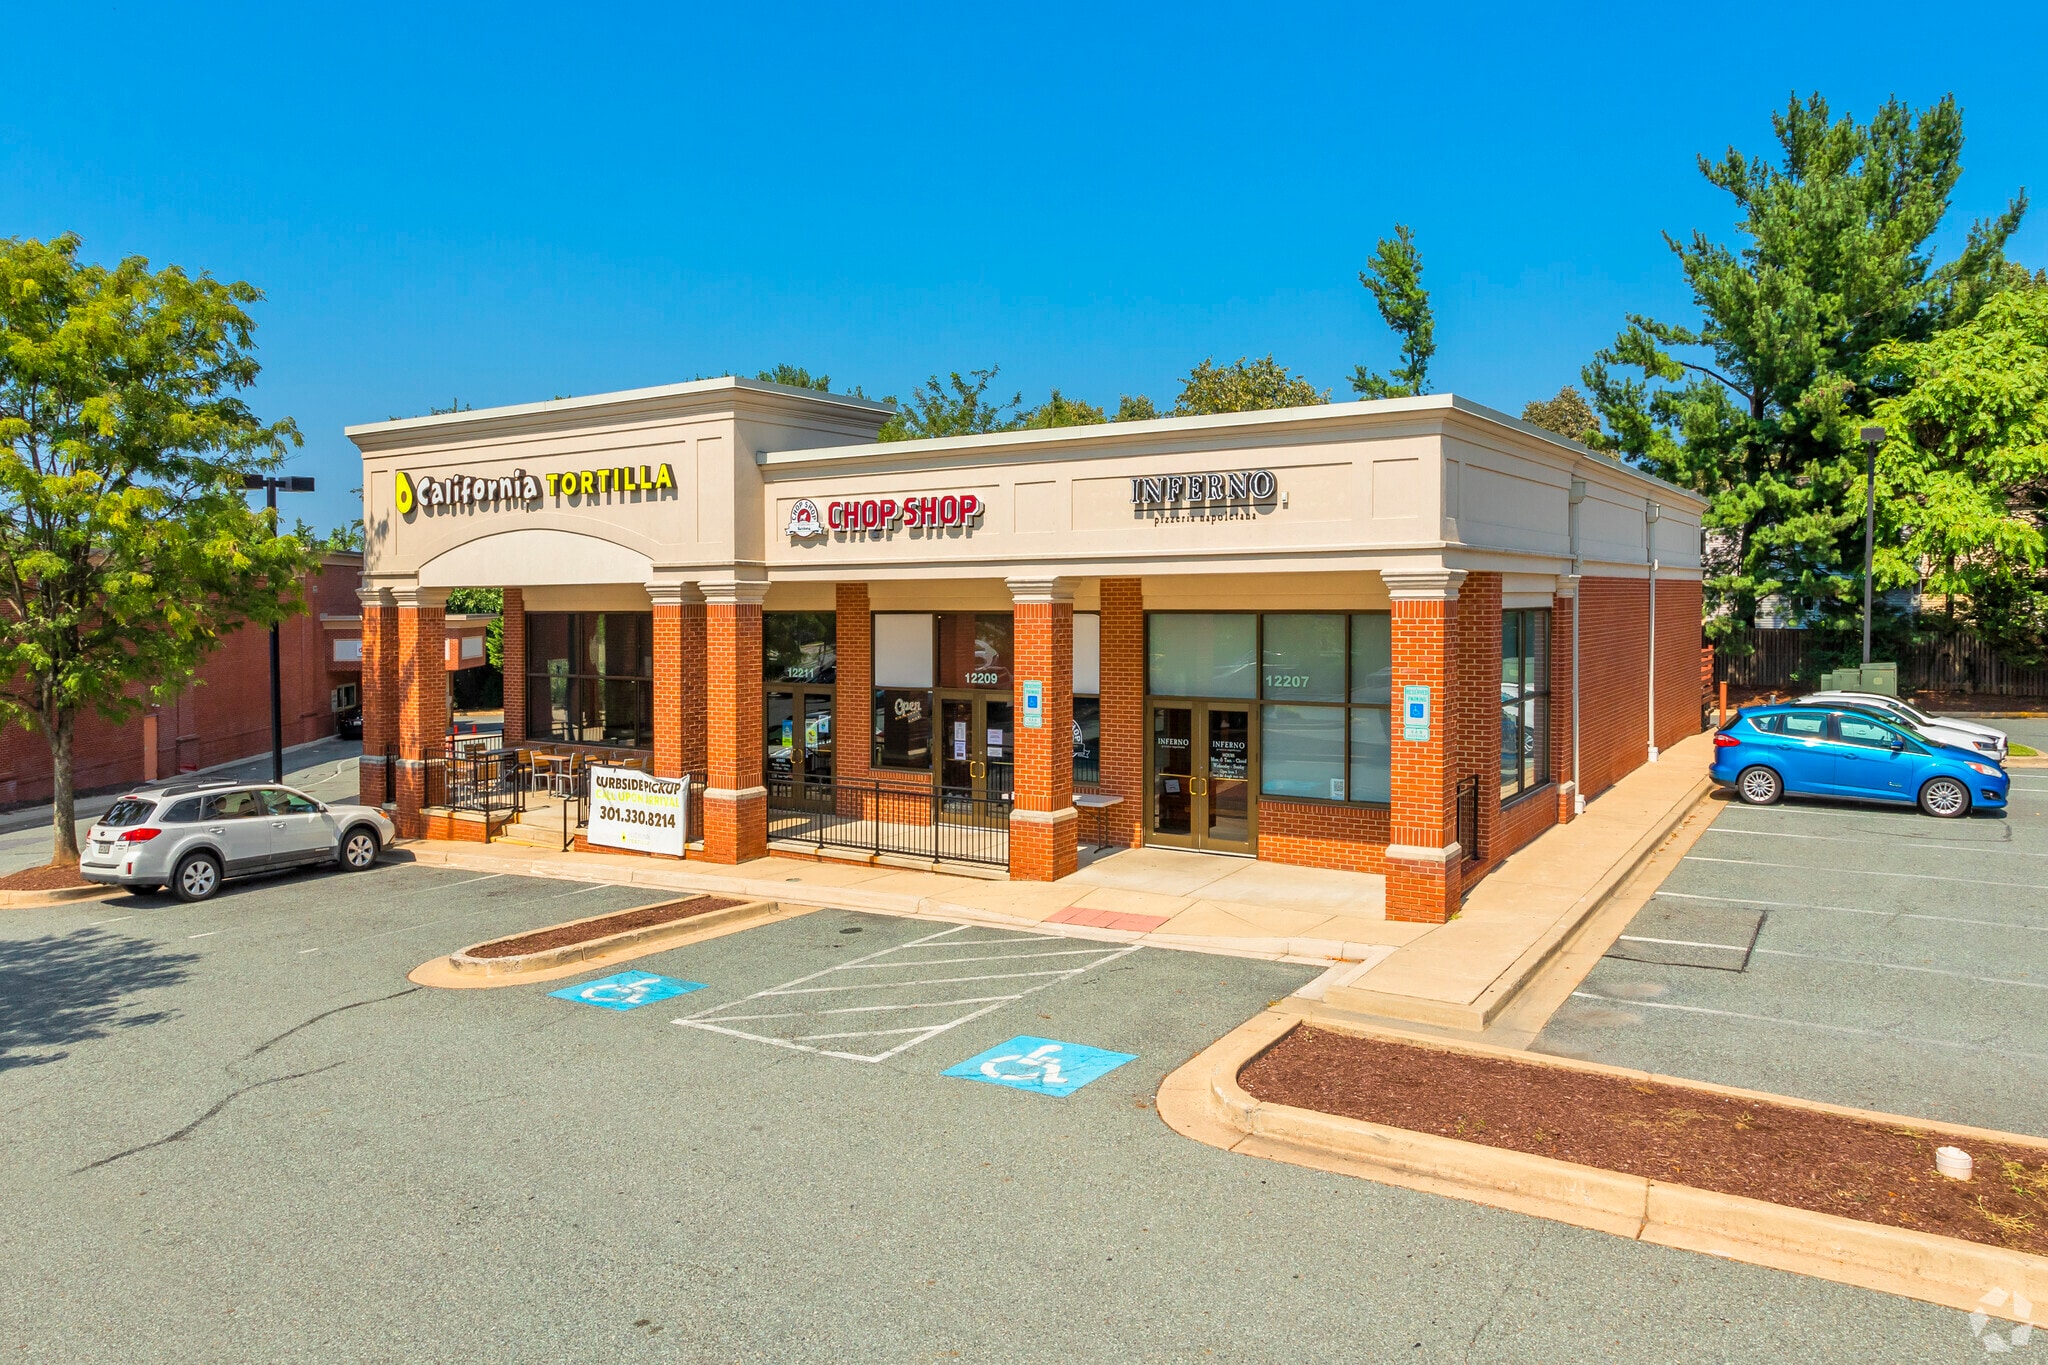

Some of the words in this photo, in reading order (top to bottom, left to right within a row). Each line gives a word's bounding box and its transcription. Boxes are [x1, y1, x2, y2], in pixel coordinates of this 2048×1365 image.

[416, 468, 538, 506] California
[546, 463, 673, 497] TORTILLA
[1131, 470, 1275, 504] INFERNO
[828, 500, 899, 531] CHOP
[904, 495, 981, 527] SHOP
[1154, 512, 1195, 527] pizzeria
[787, 667, 815, 678] 12211
[965, 672, 998, 684] 12209
[1265, 675, 1310, 688] 12207
[894, 698, 922, 716] Open
[1157, 737, 1190, 746] INFERNO
[1212, 740, 1246, 750] INFERNO
[596, 775, 643, 791] CURBSIDE
[644, 780, 682, 795] PICKUP
[595, 788, 615, 801] CALL
[618, 791, 643, 803] UPON
[645, 795, 680, 808] ARRIVAL
[599, 805, 676, 829] 301.330.8214
